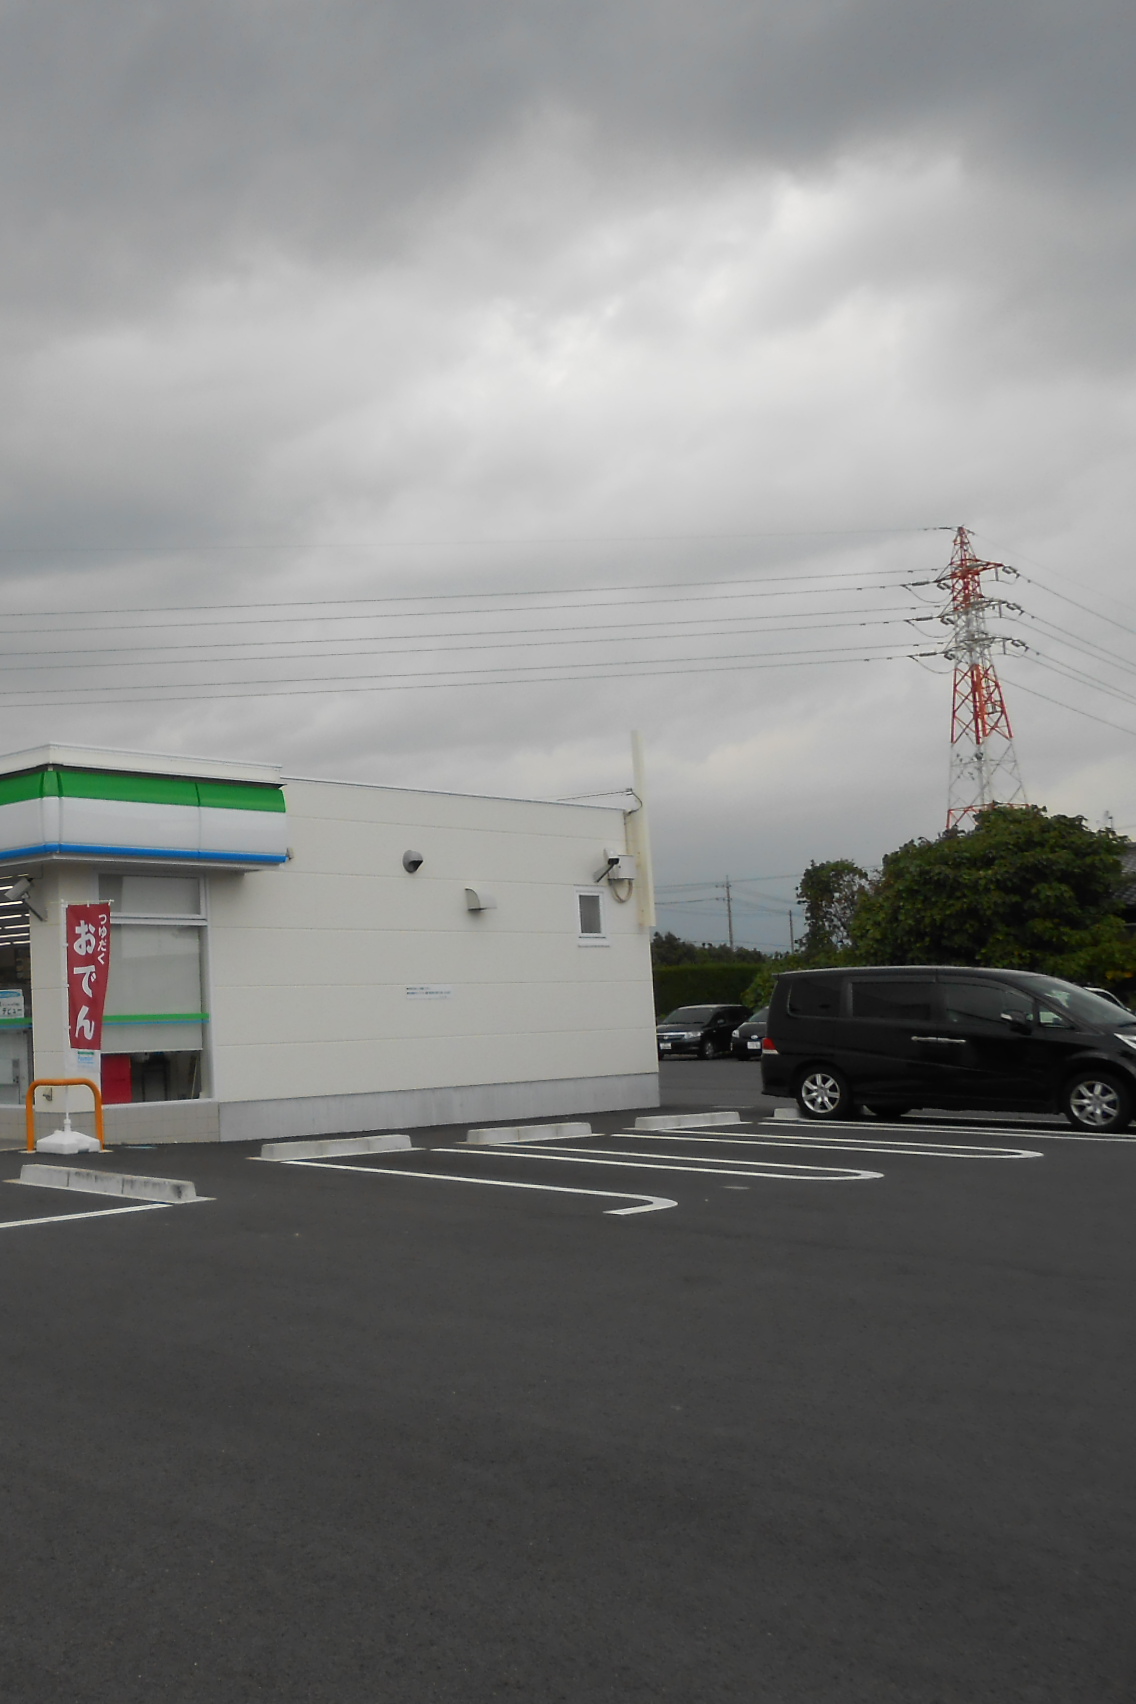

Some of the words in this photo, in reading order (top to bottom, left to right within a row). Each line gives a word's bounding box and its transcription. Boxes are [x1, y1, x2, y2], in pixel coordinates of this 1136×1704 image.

[73, 920, 97, 1041] おでん
[97, 913, 108, 965] つゆだく
